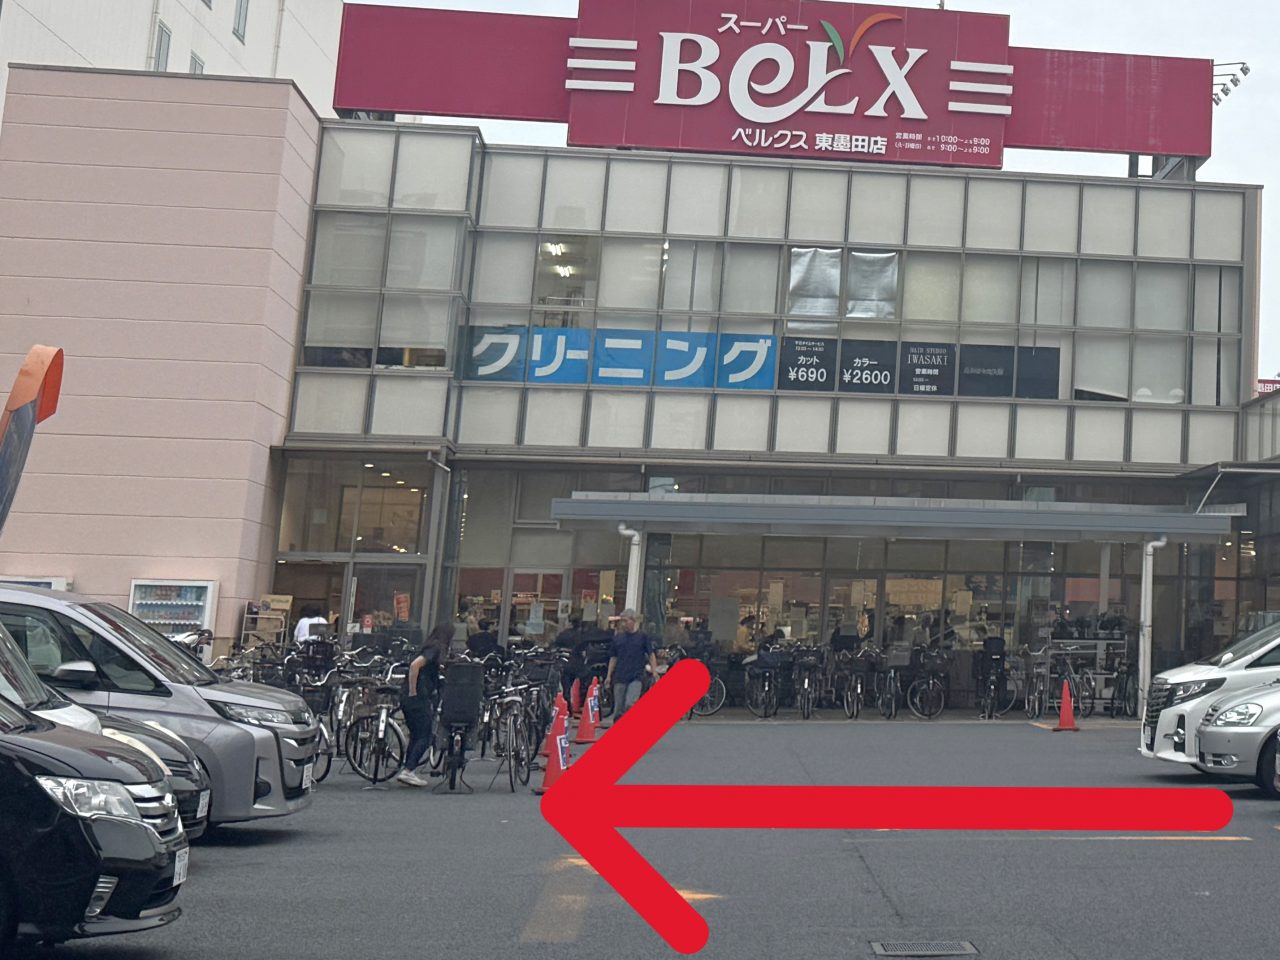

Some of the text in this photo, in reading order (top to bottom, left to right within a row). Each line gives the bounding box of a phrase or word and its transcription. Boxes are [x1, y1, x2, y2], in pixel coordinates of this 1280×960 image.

[717, 13, 809, 35] スーパー
[731, 128, 888, 155] ベルクス 東墨田店
[472, 333, 771, 383] クリーニング
[797, 355, 820, 366] カット
[853, 357, 878, 368] カラー
[907, 354, 949, 366] IWASAKI
[788, 367, 828, 382] ¥690
[842, 369, 891, 385] ¥2600
